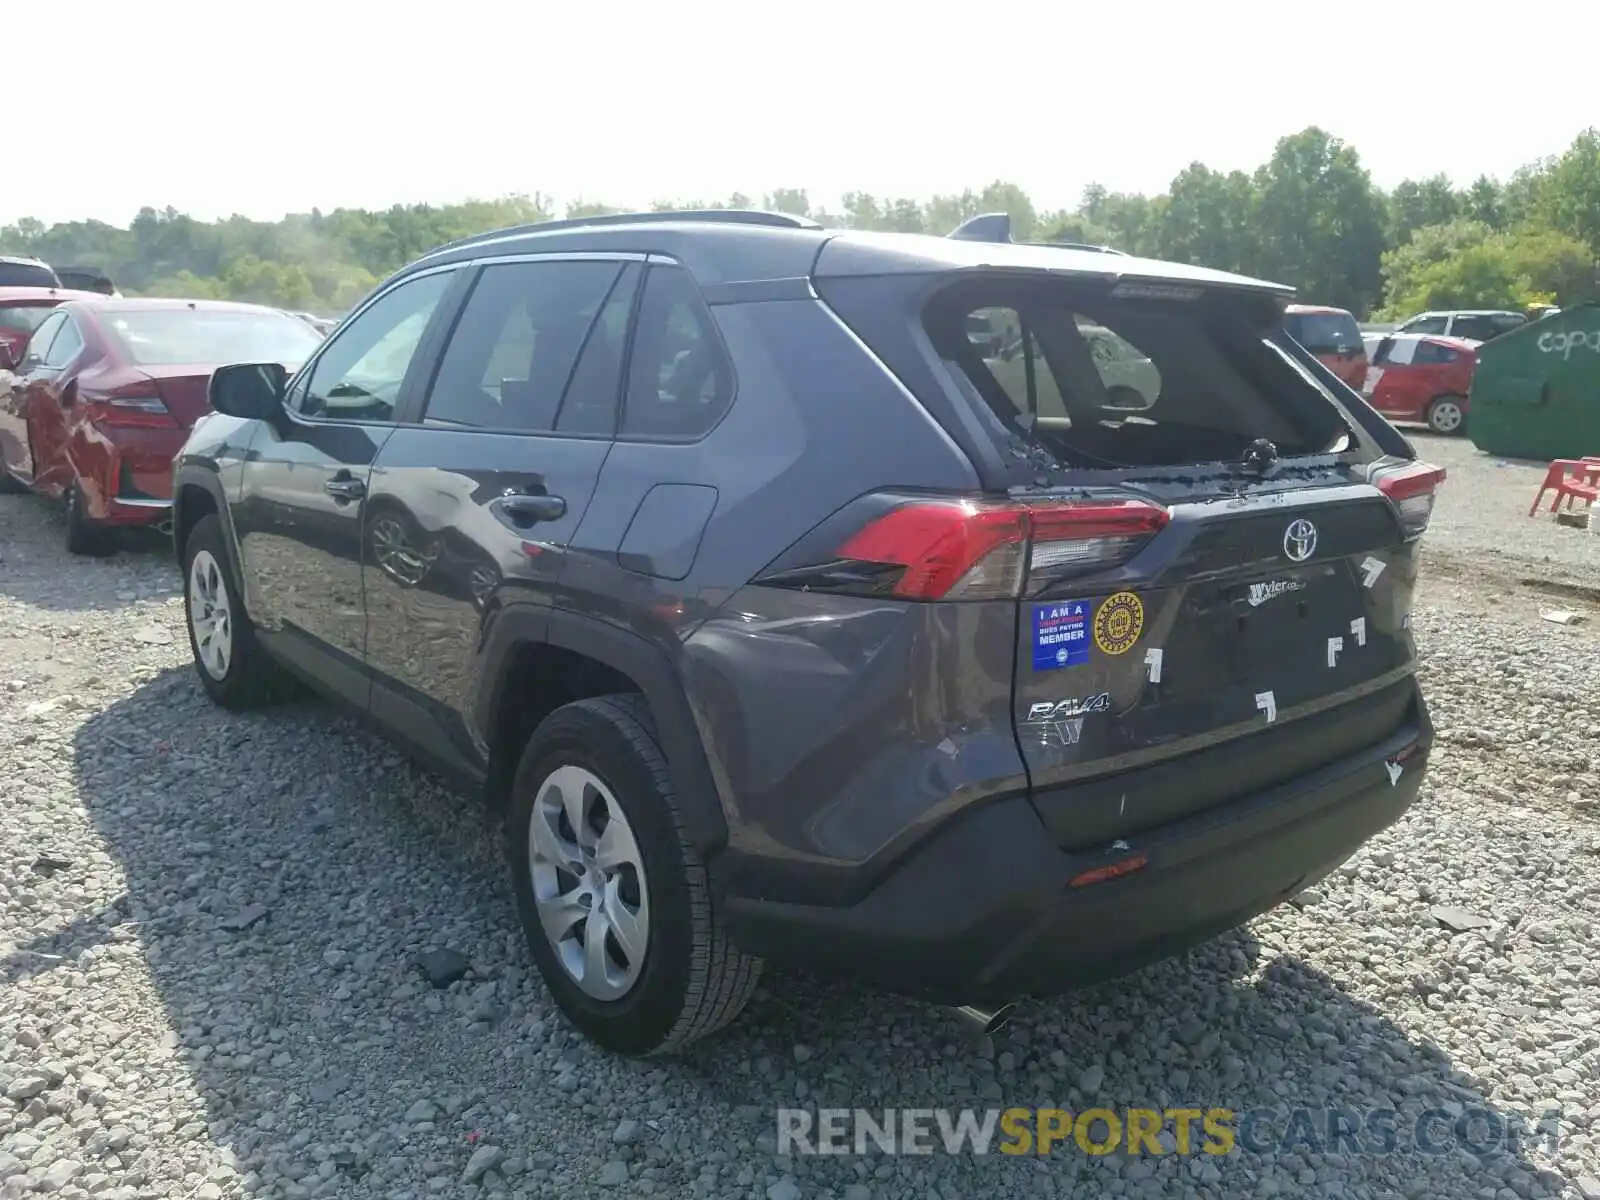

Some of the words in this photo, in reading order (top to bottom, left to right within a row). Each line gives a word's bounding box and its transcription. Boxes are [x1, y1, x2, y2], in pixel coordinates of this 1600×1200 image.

[1040, 610, 1044, 620] I
[1050, 607, 1069, 618] AM
[1075, 605, 1083, 614] A
[1039, 630, 1085, 645] MEMBER
[1027, 692, 1110, 721] RAV4
